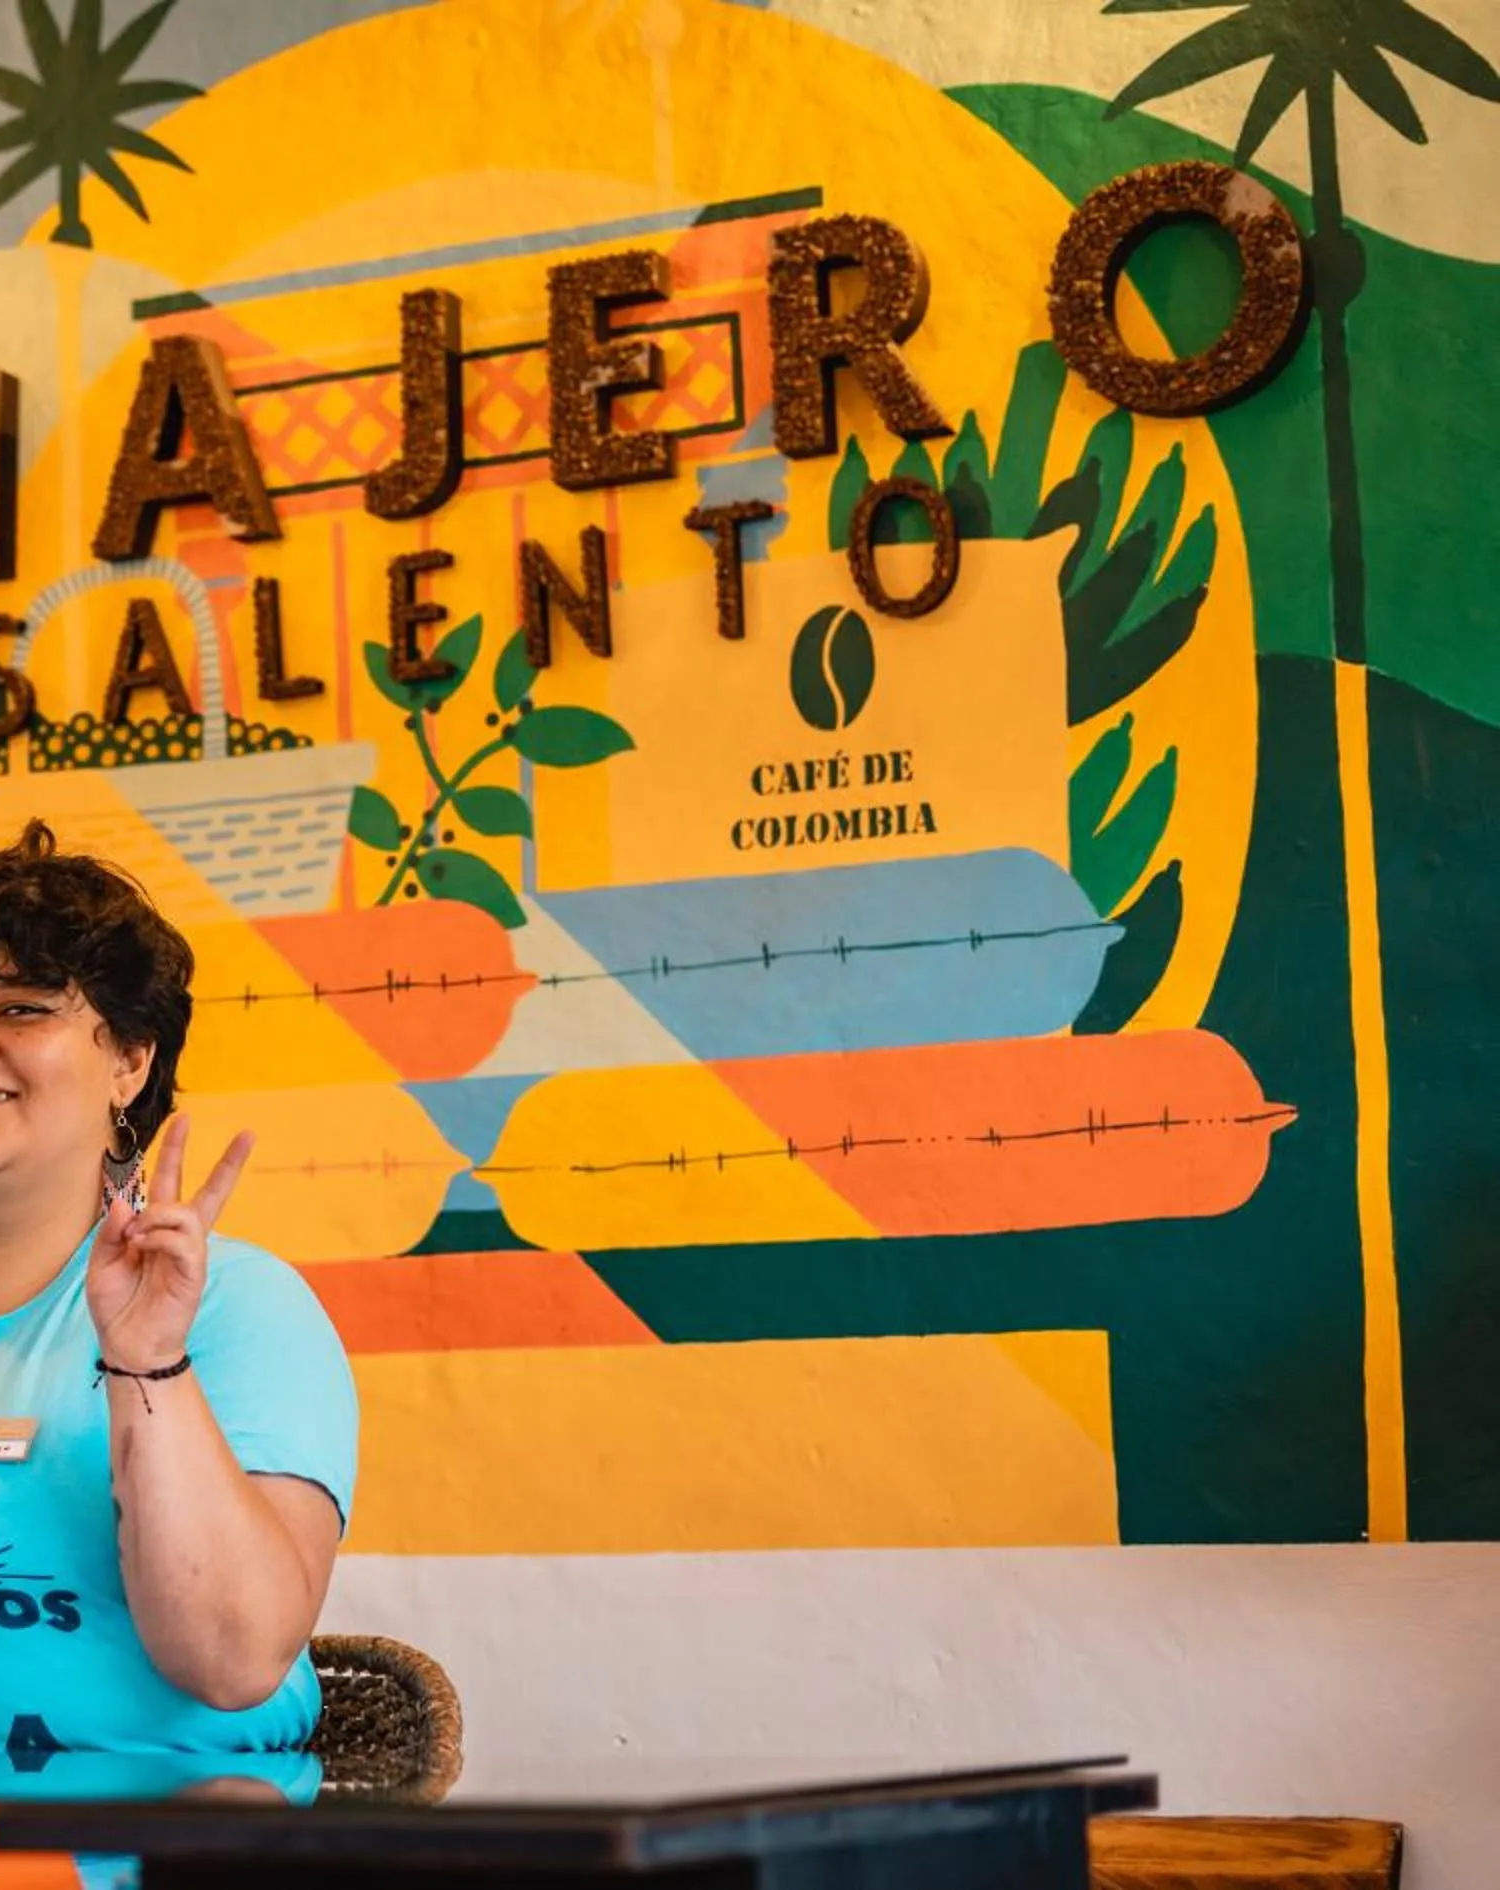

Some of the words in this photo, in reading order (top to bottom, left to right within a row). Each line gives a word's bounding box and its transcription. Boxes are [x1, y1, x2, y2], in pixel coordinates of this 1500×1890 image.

[751, 749, 850, 796] CAFÉ
[863, 750, 914, 786] DE
[731, 801, 938, 851] COLOMBIA
